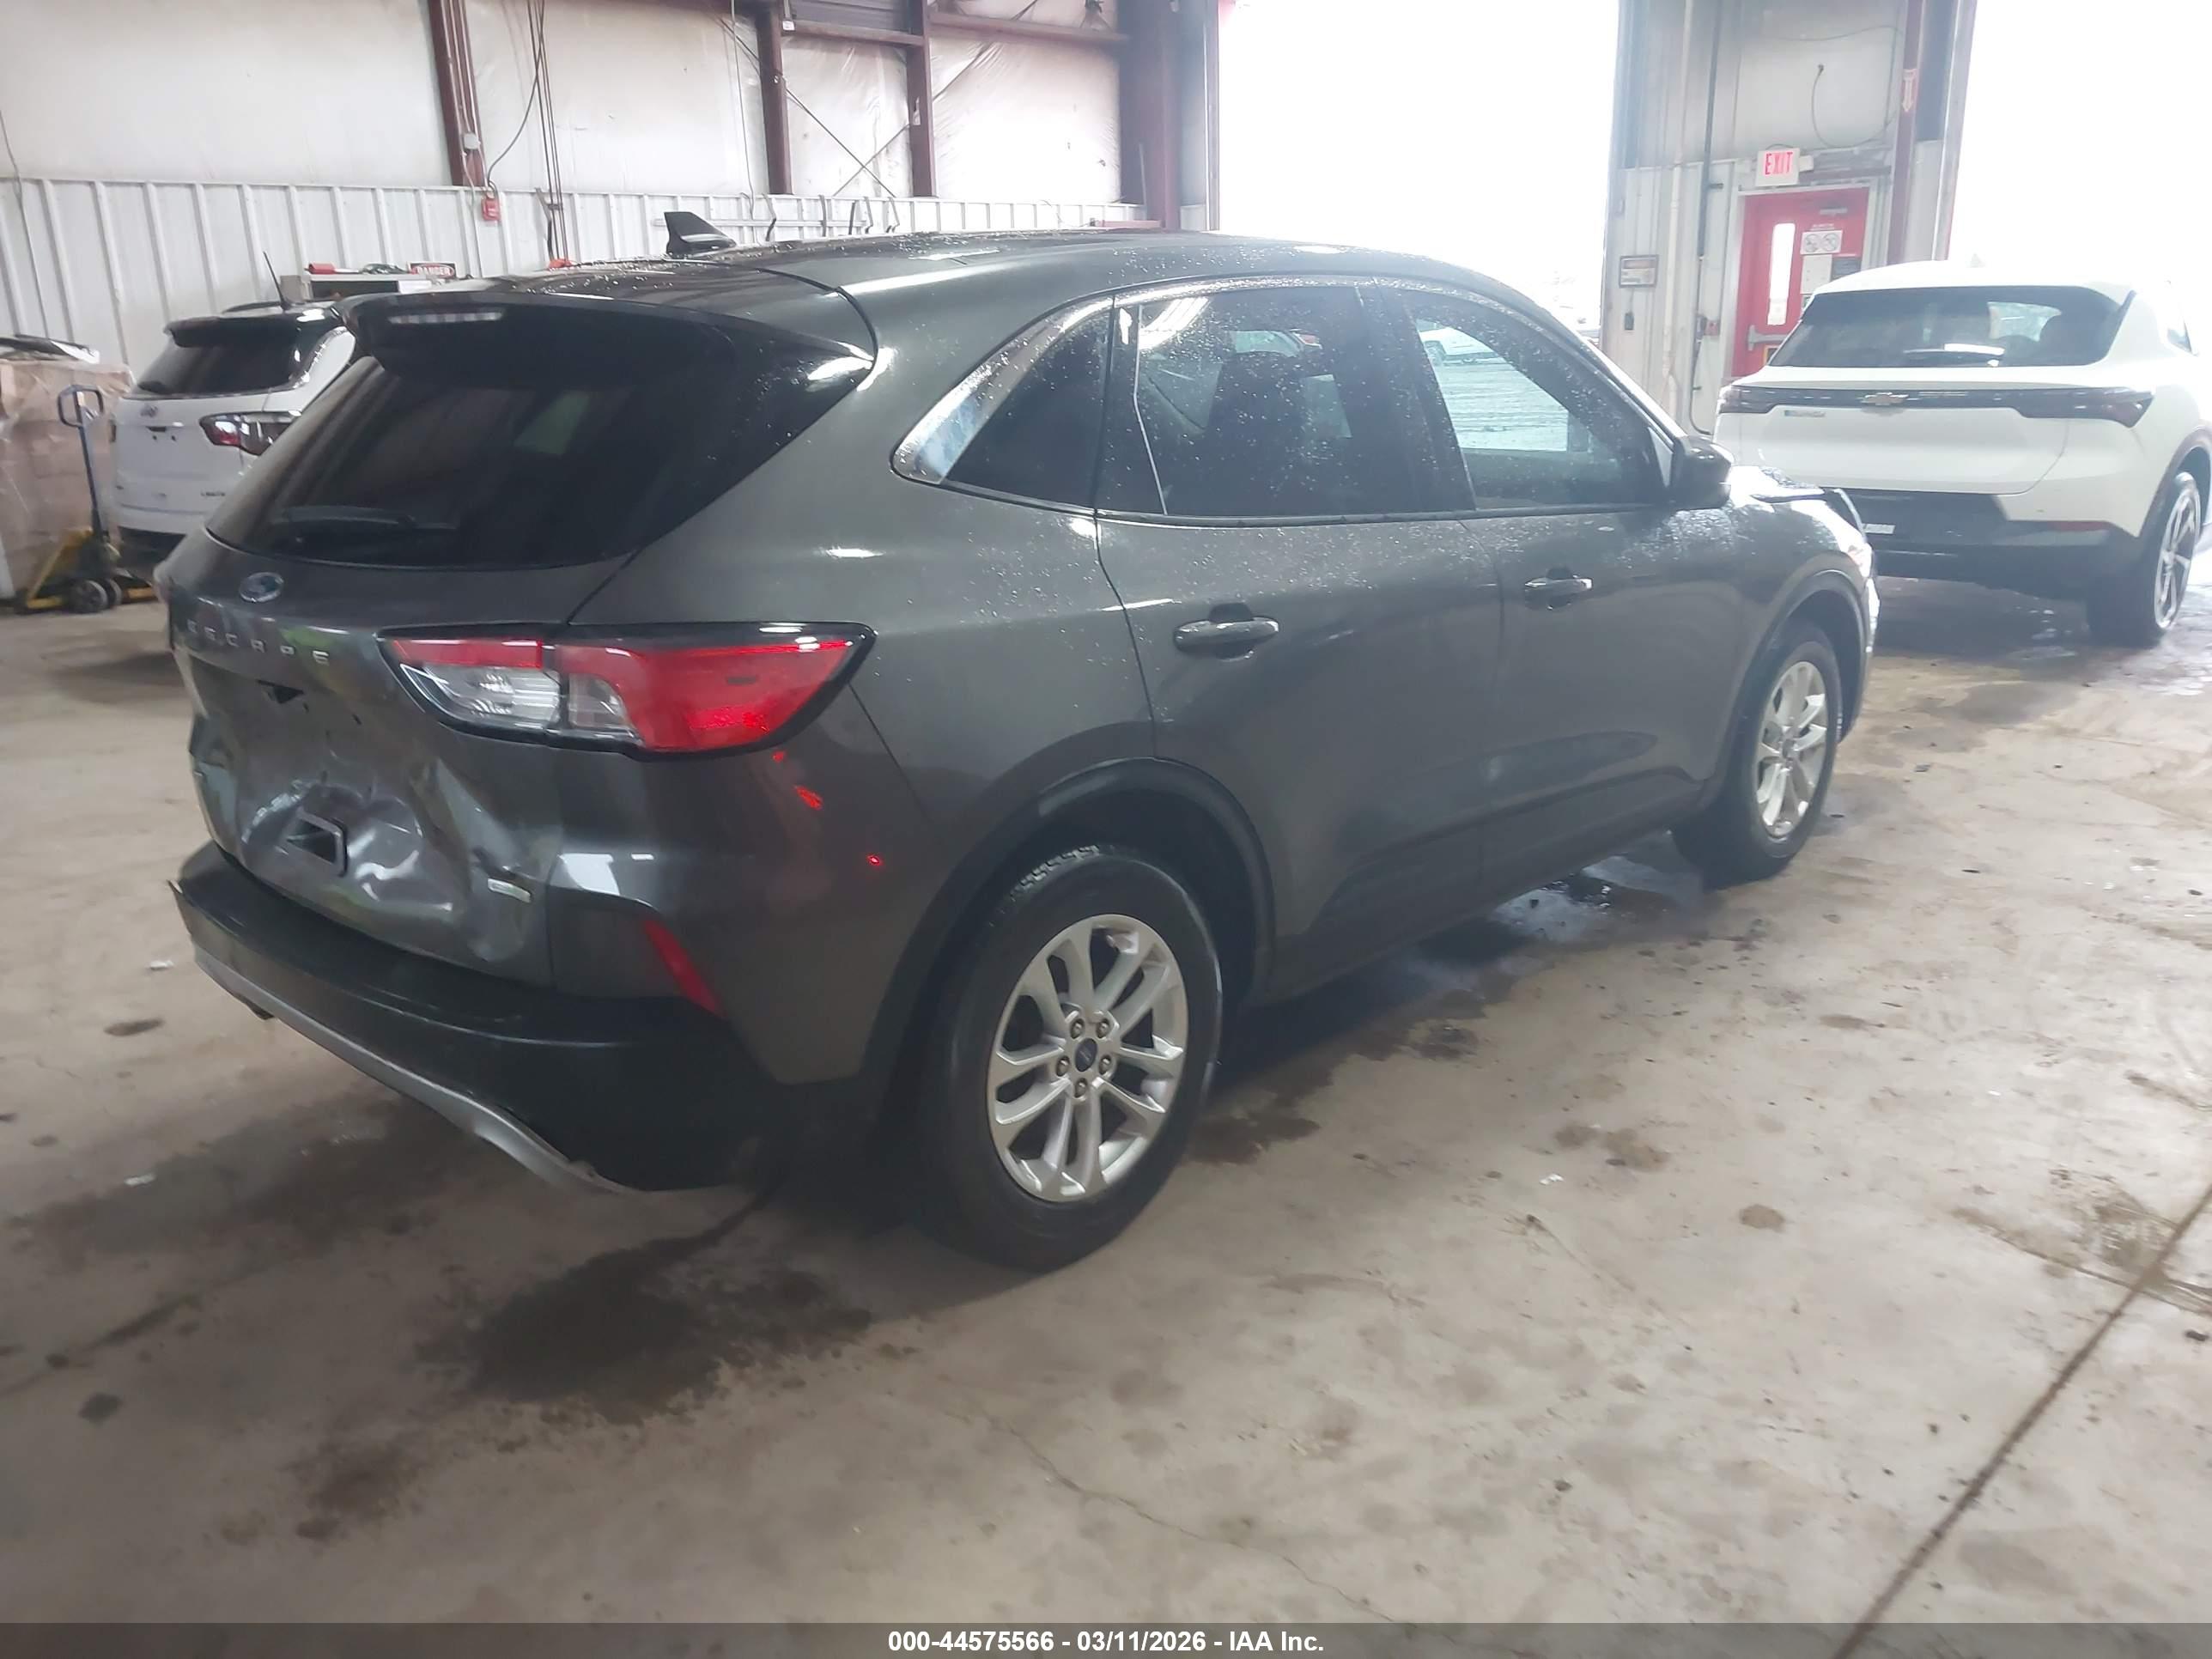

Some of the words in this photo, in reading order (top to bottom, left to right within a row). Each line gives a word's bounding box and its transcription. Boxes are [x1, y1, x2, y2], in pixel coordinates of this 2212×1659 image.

[1765, 151, 1794, 175] EXIT
[416, 266, 452, 276] DANGER
[186, 618, 331, 665] ESCAPE
